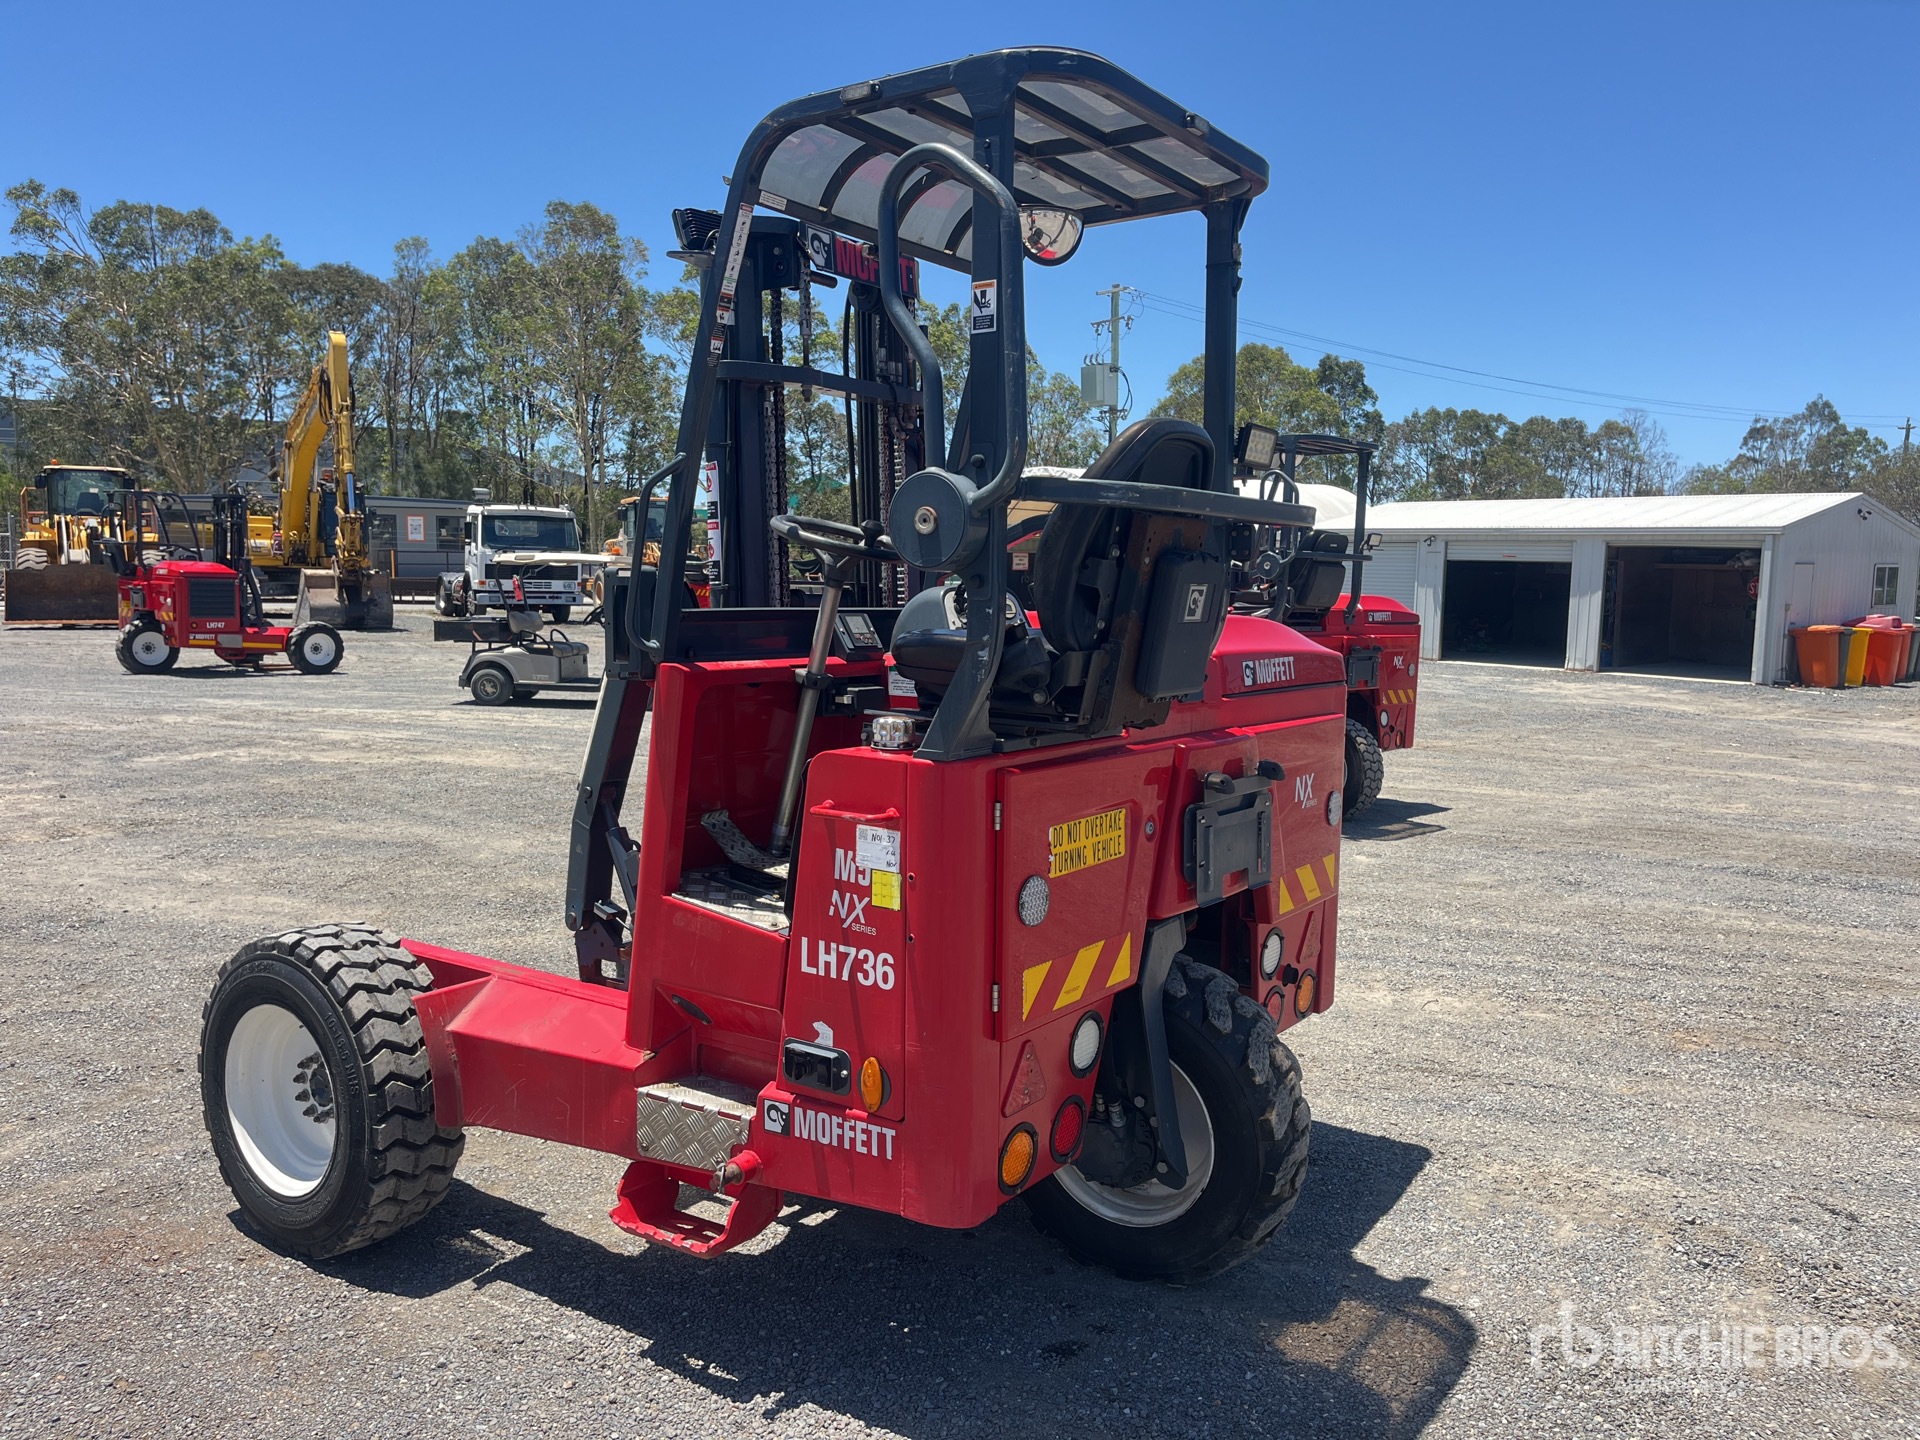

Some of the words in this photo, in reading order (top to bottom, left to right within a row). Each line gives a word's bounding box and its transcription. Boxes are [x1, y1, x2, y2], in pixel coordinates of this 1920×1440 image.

[835, 236, 917, 294] MOFTT
[206, 621, 225, 629] LH747
[1374, 611, 1392, 622] MOFFETT
[1255, 656, 1295, 684] MOFFETT
[1393, 655, 1404, 669] NX
[1295, 772, 1315, 809] NX
[1053, 826, 1064, 849] DO
[1067, 820, 1082, 845] NOT
[1085, 810, 1123, 840] OVERTAKE
[1053, 845, 1087, 875] TURNING
[1092, 835, 1122, 863] VEHICLE
[828, 889, 871, 929] NX
[851, 922, 877, 936] SERIES
[800, 936, 895, 991] LH736
[794, 1106, 896, 1161] MOFFETT
